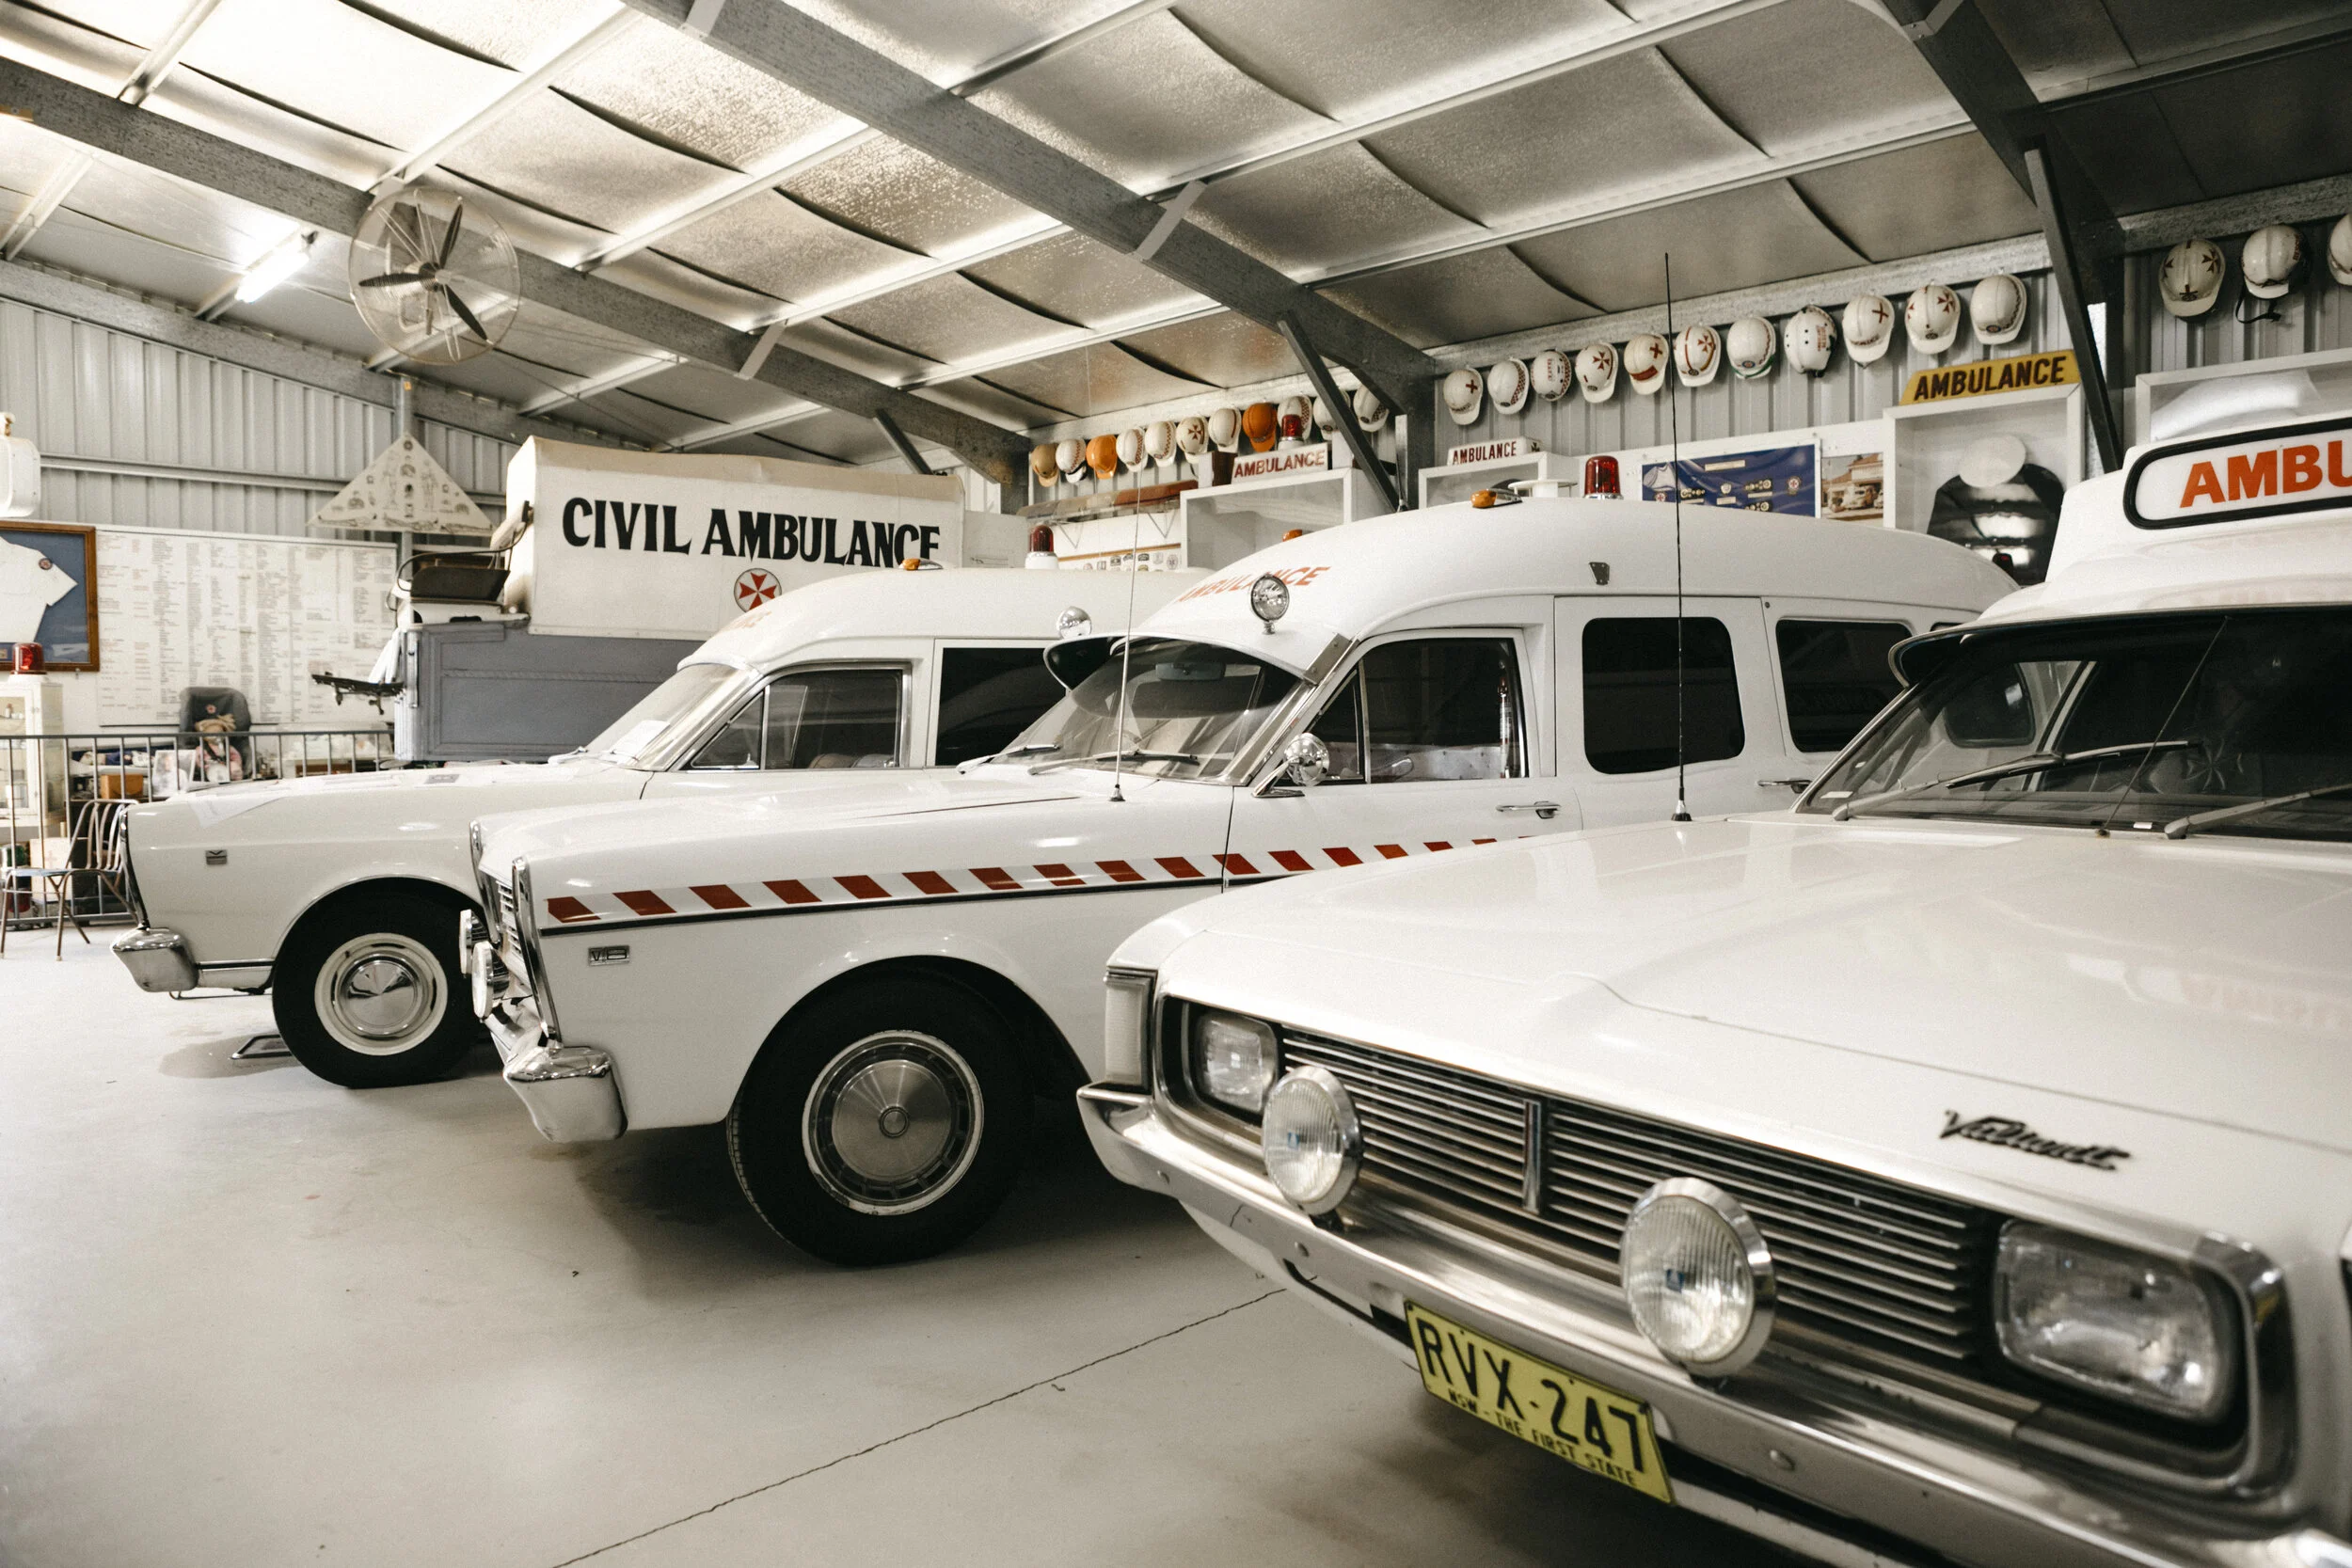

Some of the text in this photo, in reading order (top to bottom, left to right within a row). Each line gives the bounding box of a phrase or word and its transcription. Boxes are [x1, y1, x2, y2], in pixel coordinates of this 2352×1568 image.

[1914, 356, 2066, 401] AMBULANCE
[1233, 450, 1326, 478] AMBULANCE
[1452, 441, 1517, 465] AMBULANCE
[563, 497, 941, 568] CIVIL AMBULANCE
[1448, 1388, 1477, 1414] NSW
[1495, 1412, 1524, 1436] THE
[1532, 1429, 1576, 1459] FIRST
[1584, 1453, 1636, 1486] STATE
